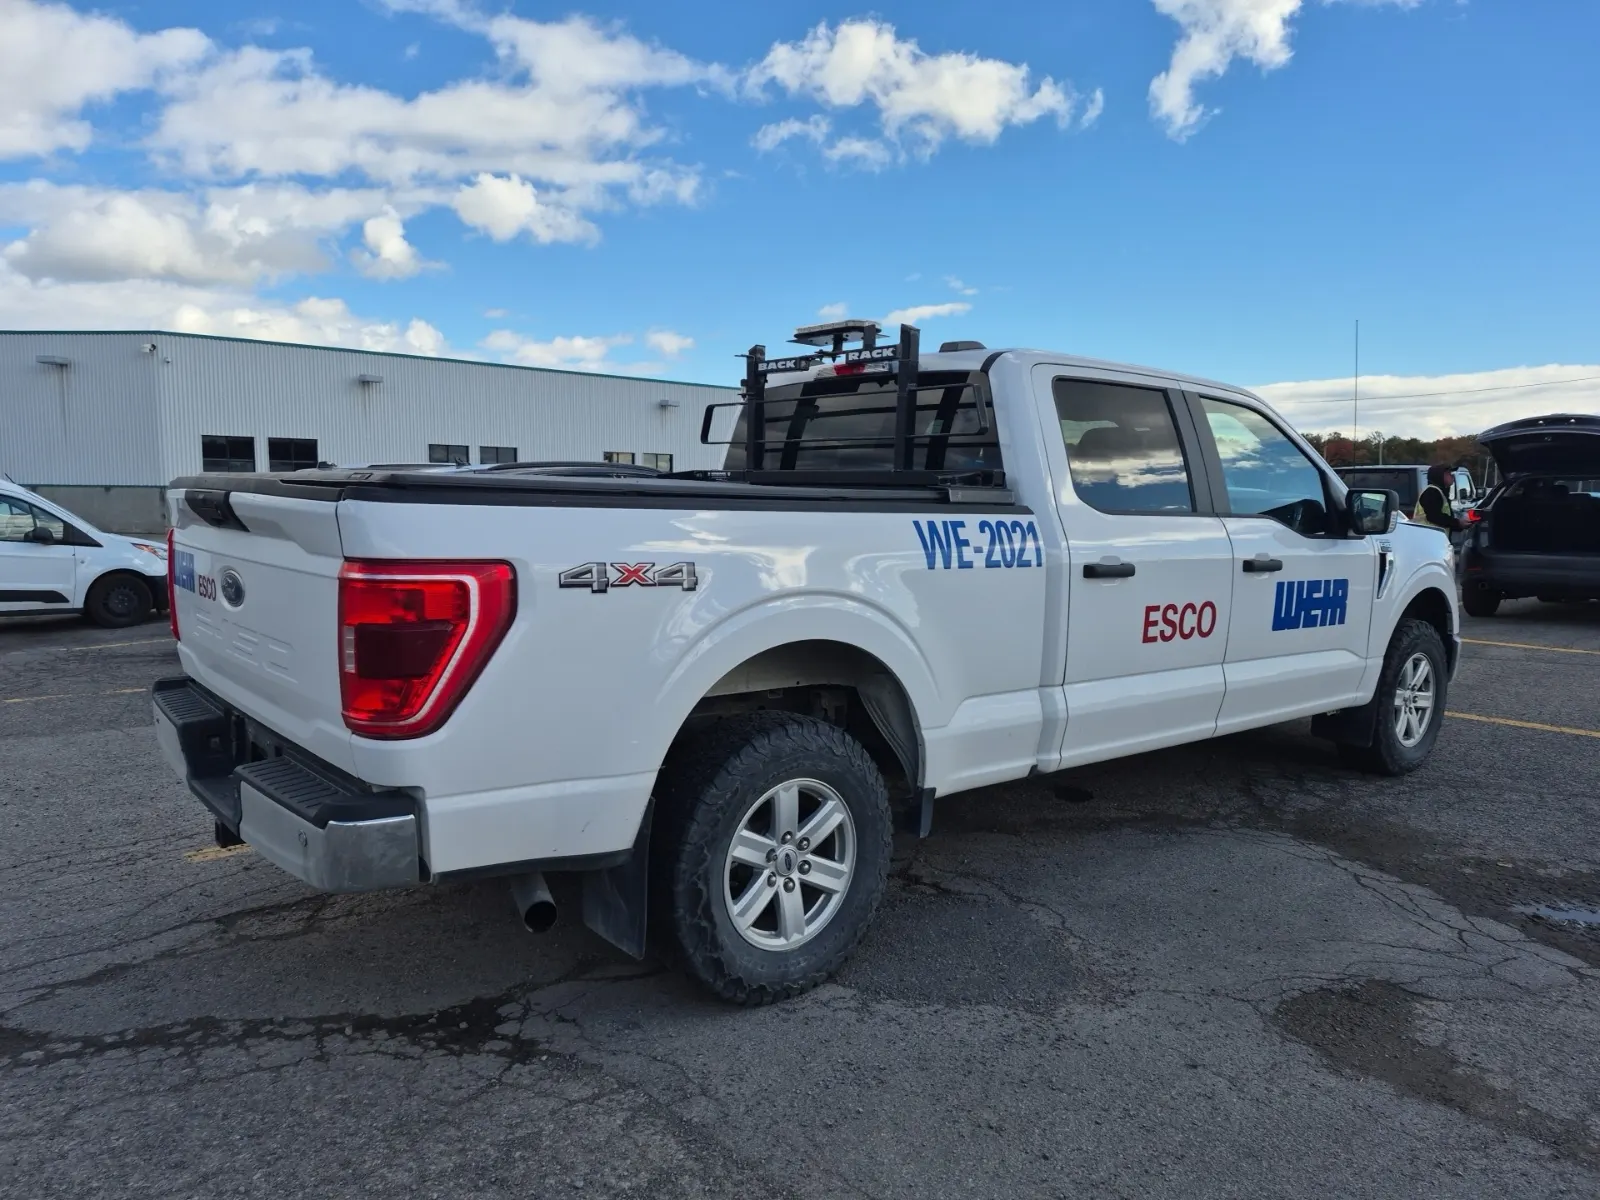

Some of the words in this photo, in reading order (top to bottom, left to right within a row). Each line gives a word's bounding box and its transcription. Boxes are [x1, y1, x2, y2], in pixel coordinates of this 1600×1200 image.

[758, 360, 796, 371] BACK
[848, 348, 895, 361] RACK
[912, 520, 1043, 570] WE-2021
[198, 574, 217, 602] ESCO
[1272, 578, 1349, 631] WEIR
[1142, 600, 1217, 643] ESCO
